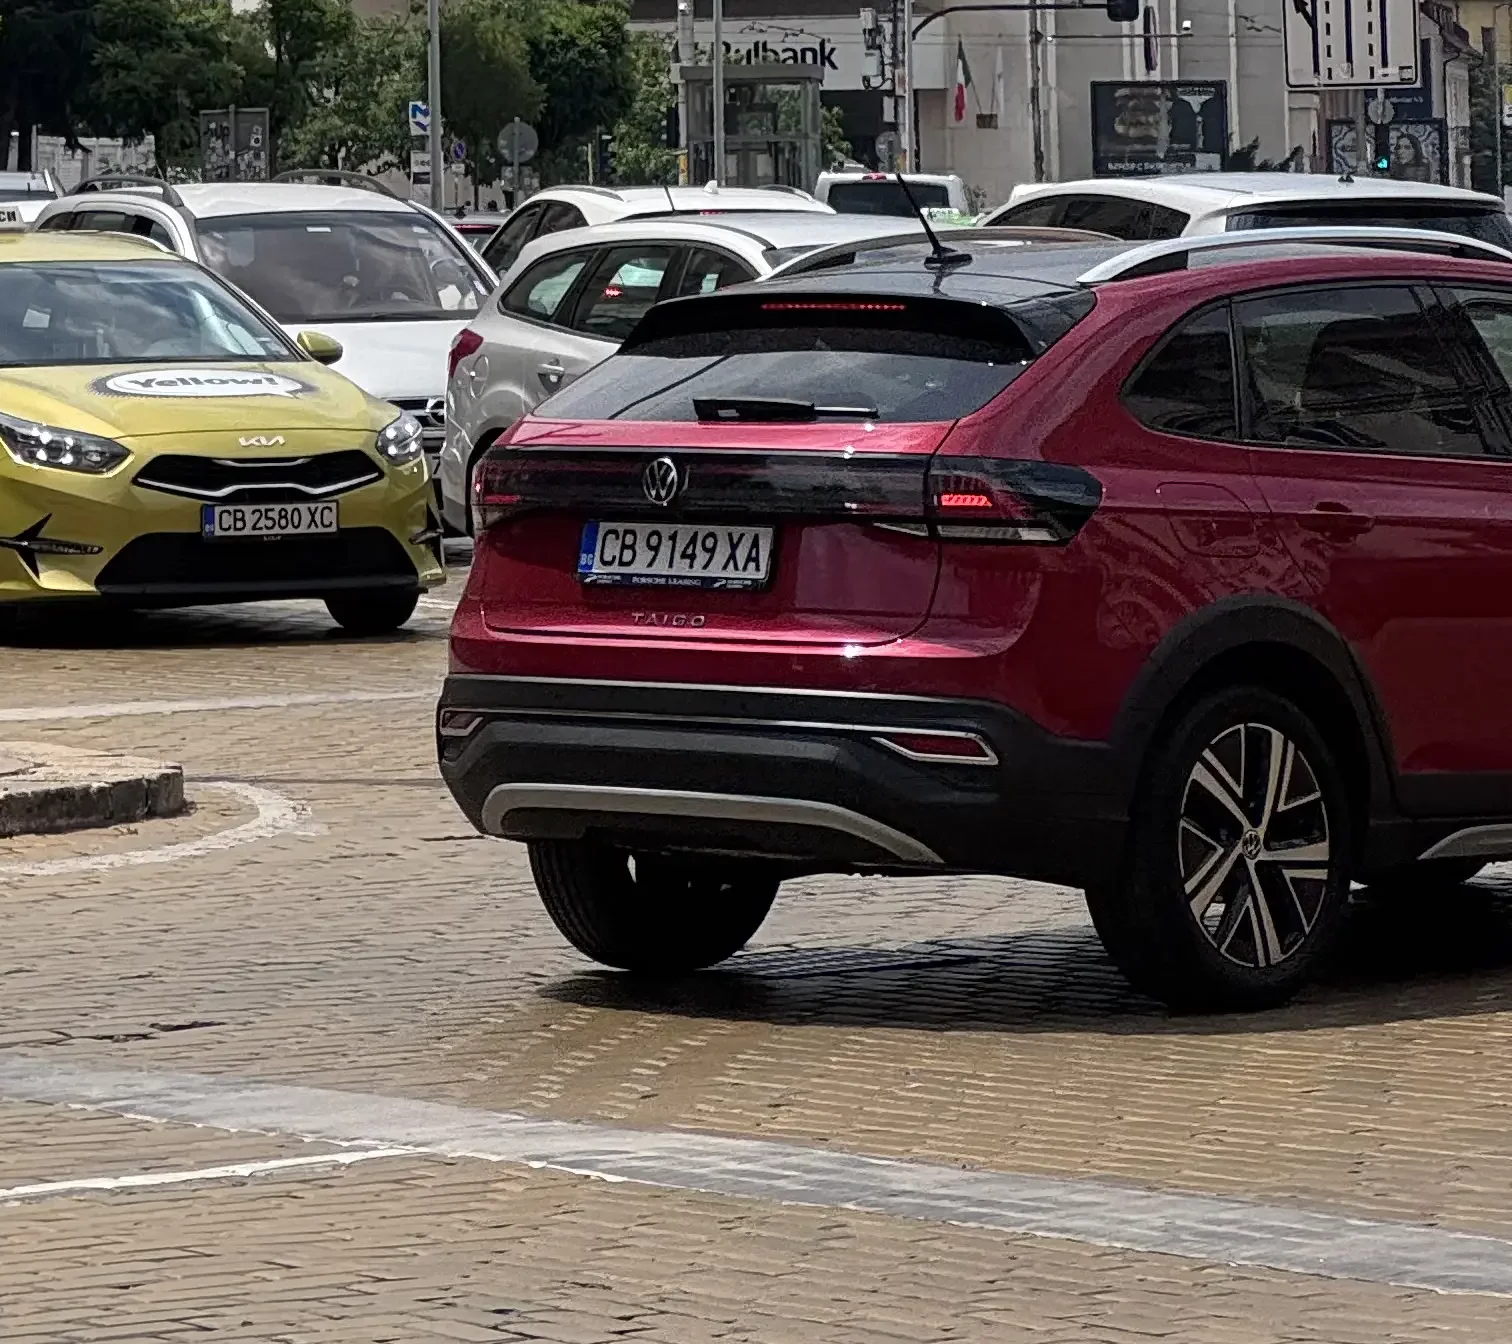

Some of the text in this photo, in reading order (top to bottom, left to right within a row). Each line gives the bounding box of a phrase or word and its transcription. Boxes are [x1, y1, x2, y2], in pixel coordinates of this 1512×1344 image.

[127, 376, 280, 389] Yellow!
[218, 509, 247, 532] CB
[251, 507, 303, 531] 2580
[307, 506, 334, 530] XC
[599, 528, 761, 572] CB 9149 XA
[631, 611, 706, 627] TAIGO
